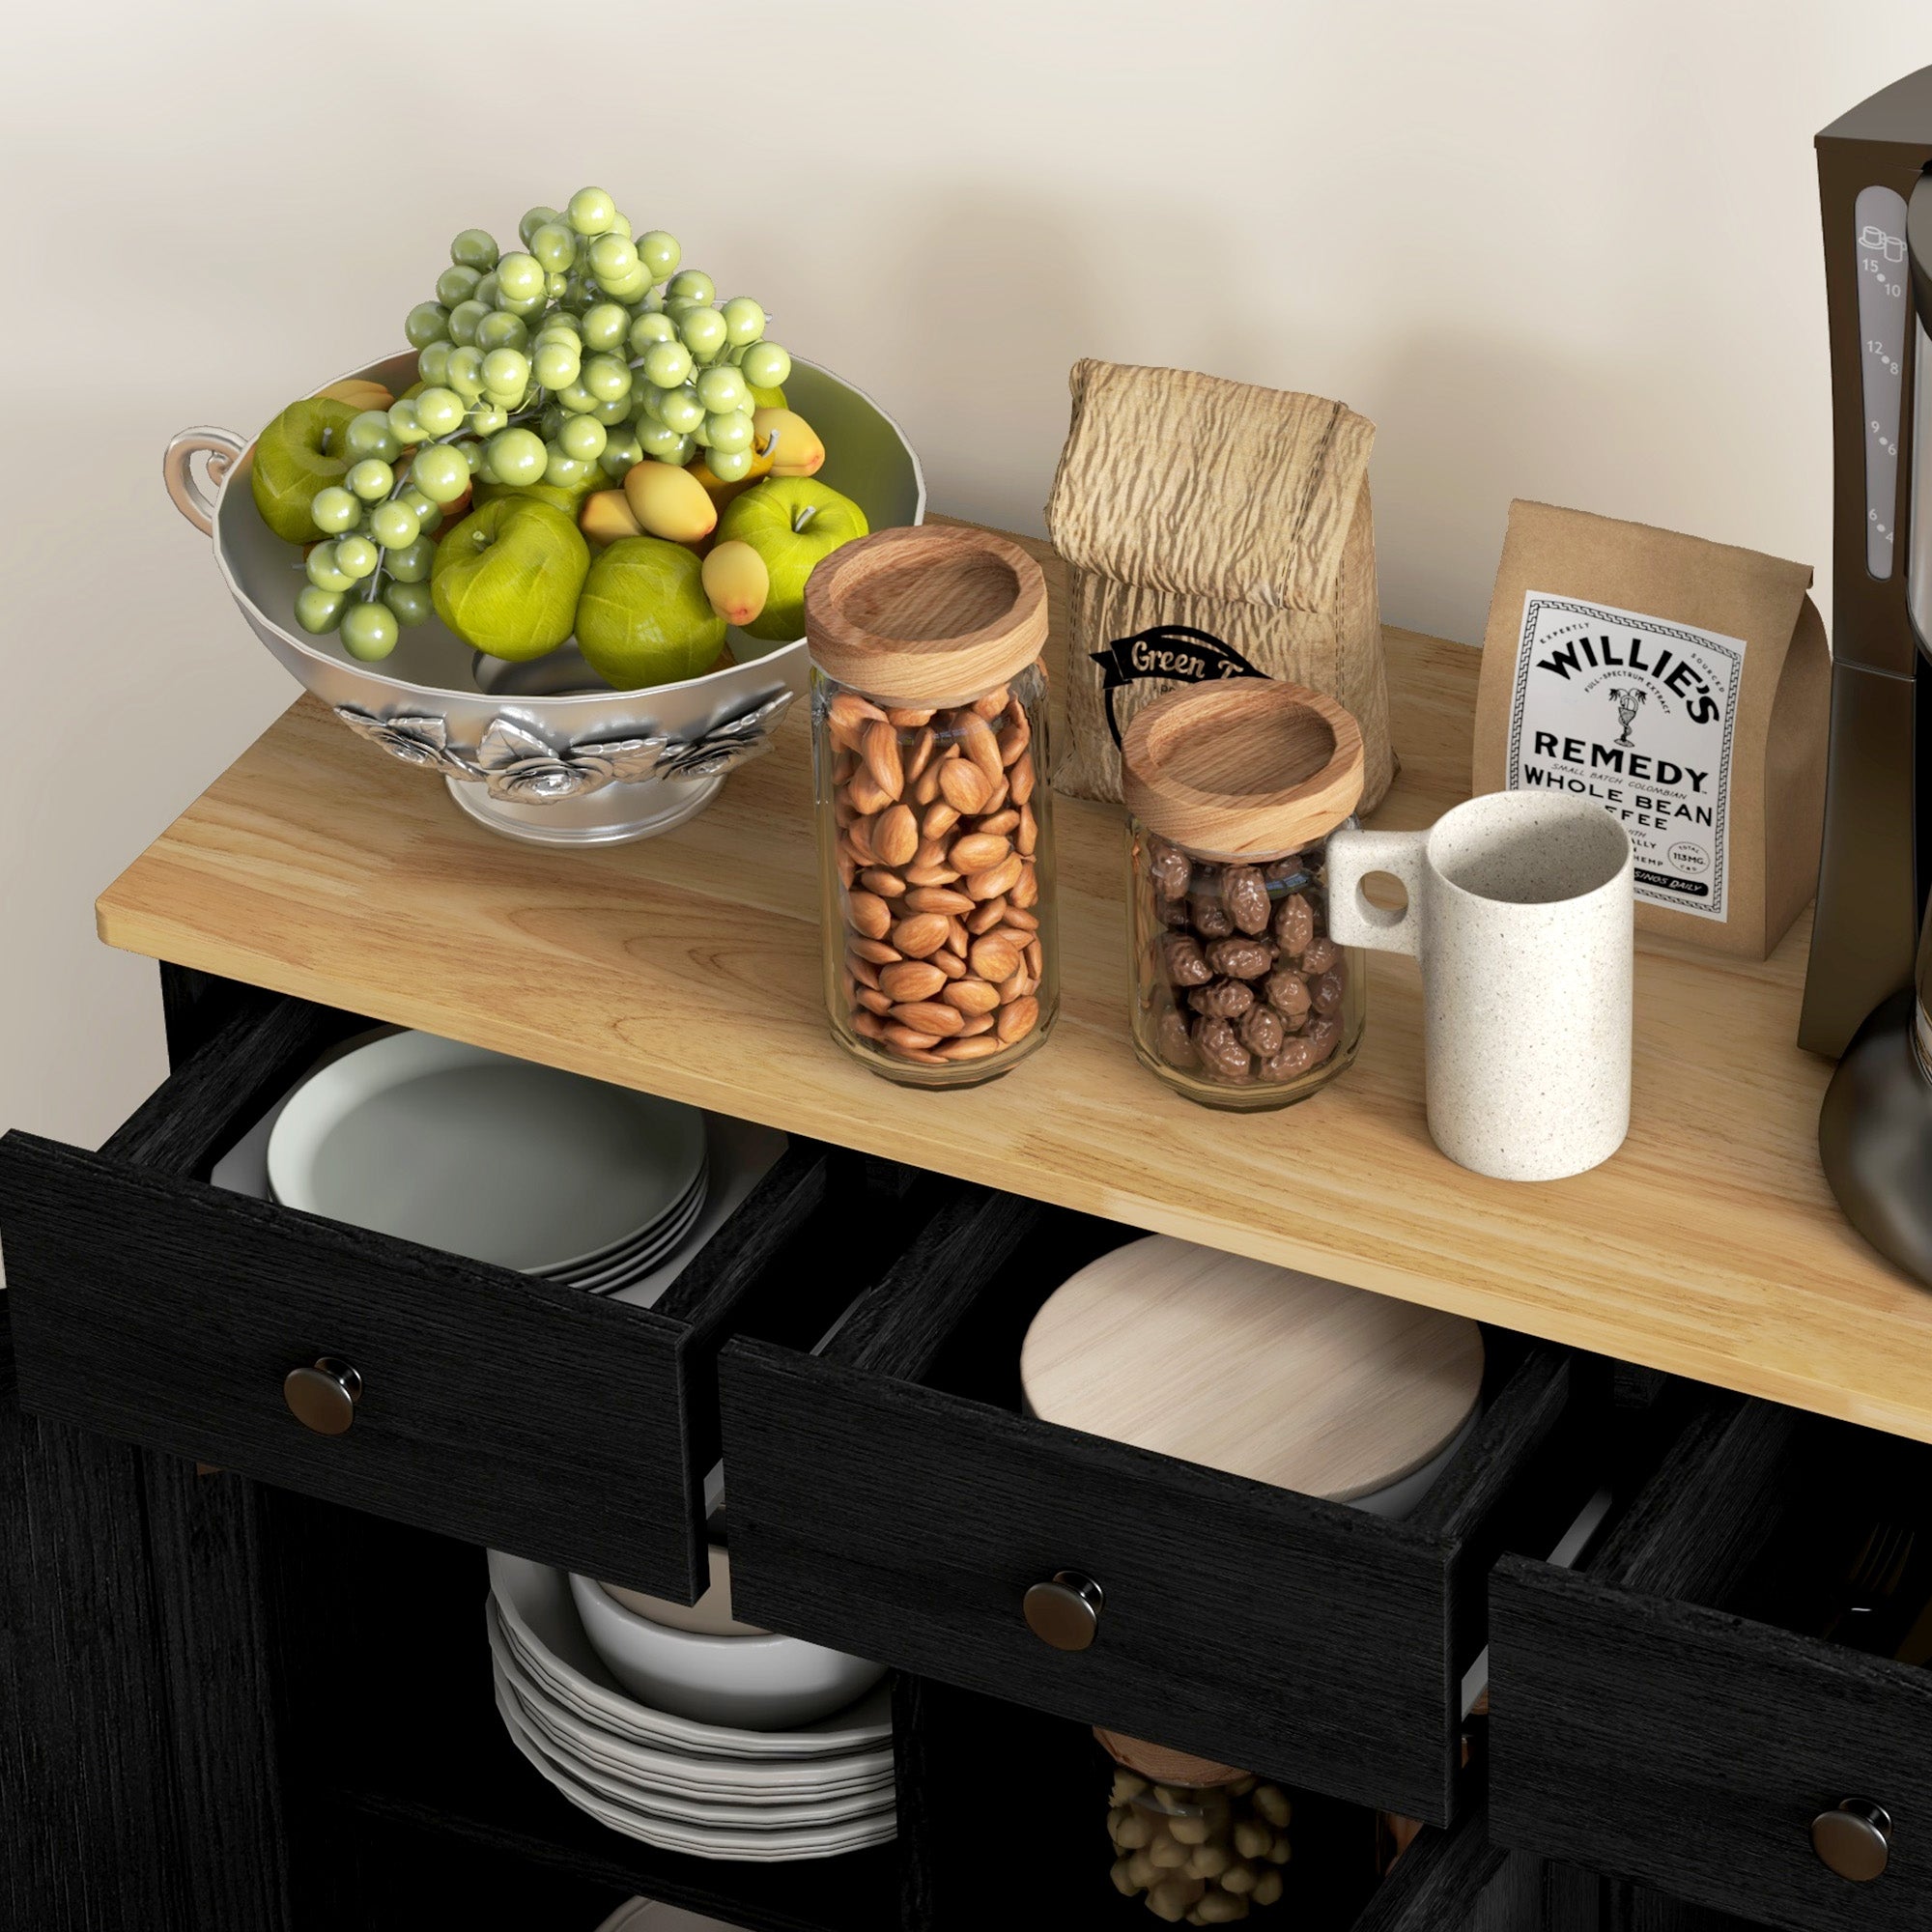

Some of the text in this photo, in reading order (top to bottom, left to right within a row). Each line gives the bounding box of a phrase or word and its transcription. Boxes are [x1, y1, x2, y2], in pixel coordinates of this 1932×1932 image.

[1861, 258, 1901, 298] 15 10
[1866, 340, 1899, 375] 12 8
[1870, 420, 1897, 456] 9 6
[1868, 508, 1894, 544] 6 4
[1539, 622, 1589, 644] EXPERTLY
[1131, 640, 1206, 679] Green
[1690, 652, 1725, 694] SOURCED
[1536, 636, 1719, 724] WILLIE'S
[1645, 681, 1671, 715] EXTRACT
[1534, 730, 1709, 793] REMEDY
[1523, 763, 1713, 827] WHOLE BEAN
[1550, 762, 1689, 800] SMALL BATCH COLOMBIAN
[1605, 805, 1668, 831] FFEE
[1629, 829, 1647, 838] ITH
[1634, 854, 1663, 867] HEMP
[1668, 880, 1703, 892] DAILY
